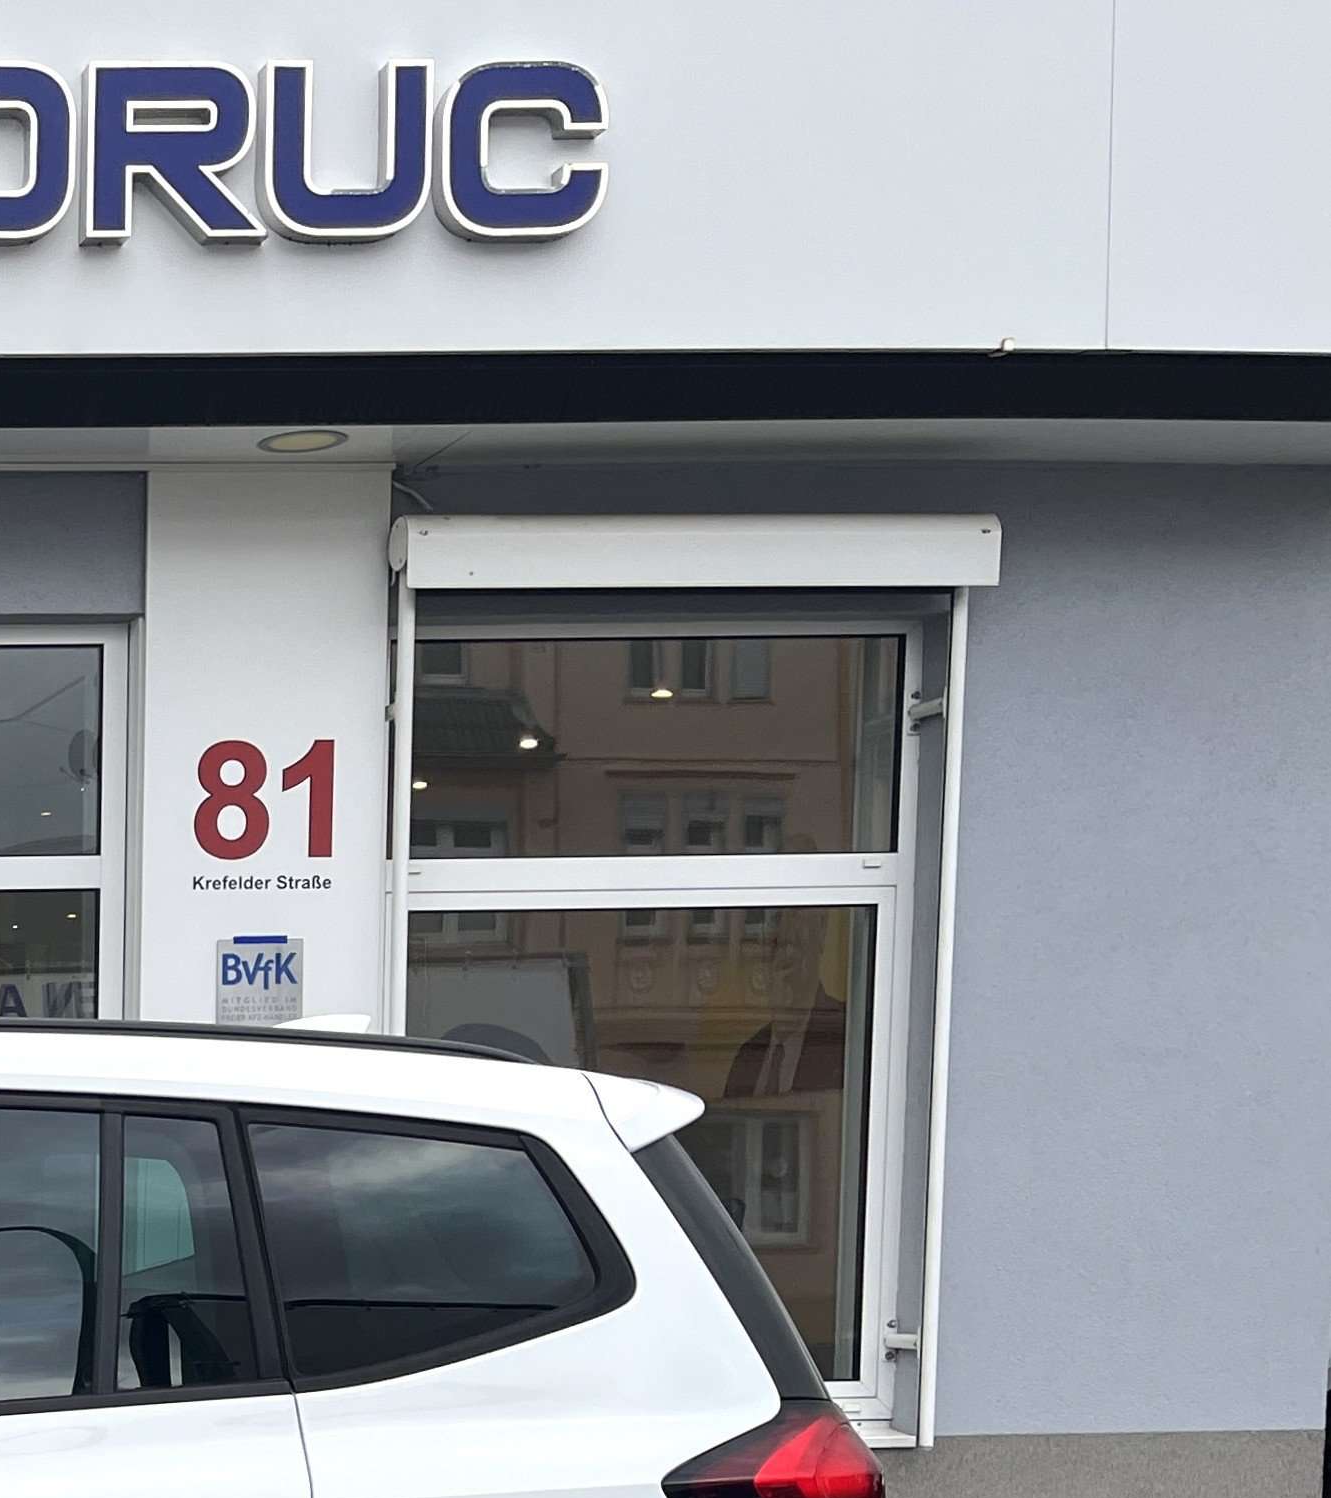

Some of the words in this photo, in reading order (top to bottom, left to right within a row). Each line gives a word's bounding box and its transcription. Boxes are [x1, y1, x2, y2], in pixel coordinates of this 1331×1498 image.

[193, 738, 336, 861] 81
[192, 874, 272, 891] Krefelder
[276, 874, 332, 891] Straße
